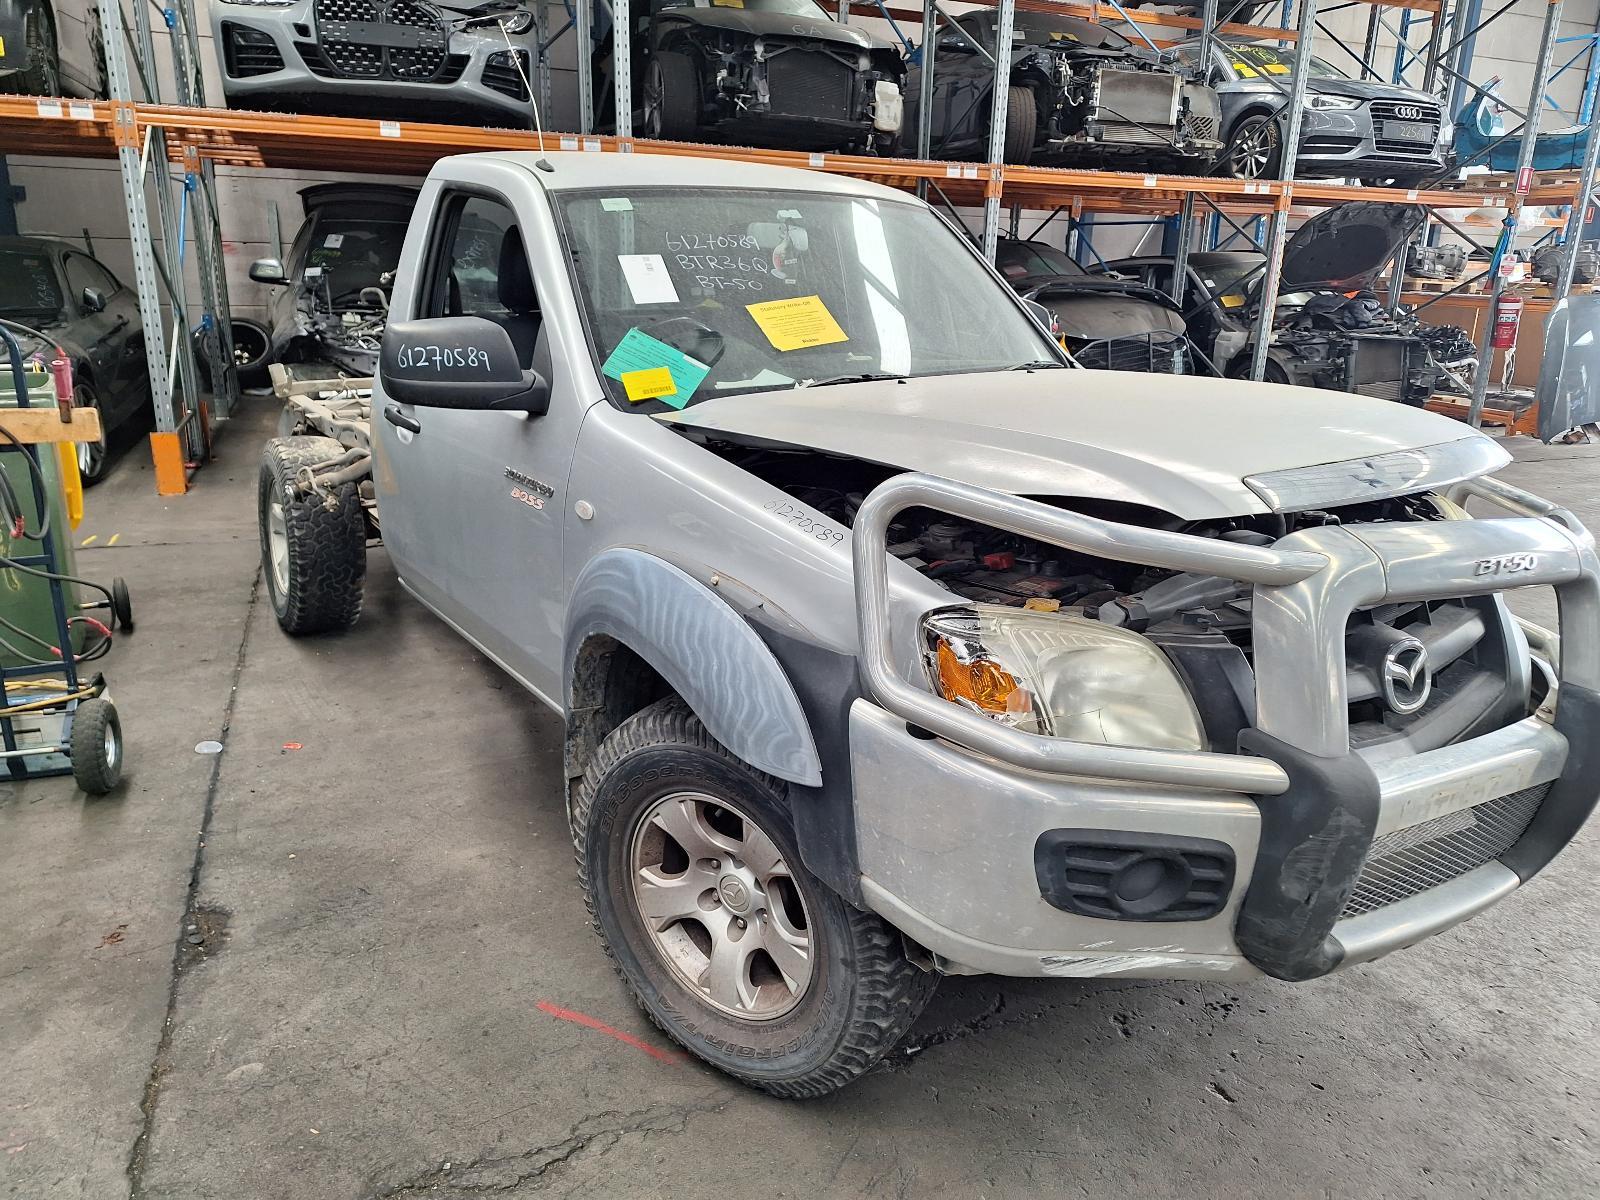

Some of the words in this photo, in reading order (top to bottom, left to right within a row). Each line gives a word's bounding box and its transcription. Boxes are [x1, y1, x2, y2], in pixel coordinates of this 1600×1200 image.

[665, 231, 760, 252] 61270589
[675, 254, 767, 274] BTR36Q
[695, 275, 763, 290] BT-50
[397, 333, 491, 372] 61270589
[511, 485, 545, 511] BOSS
[763, 499, 844, 547] 61270589
[1474, 553, 1538, 576] BT-50
